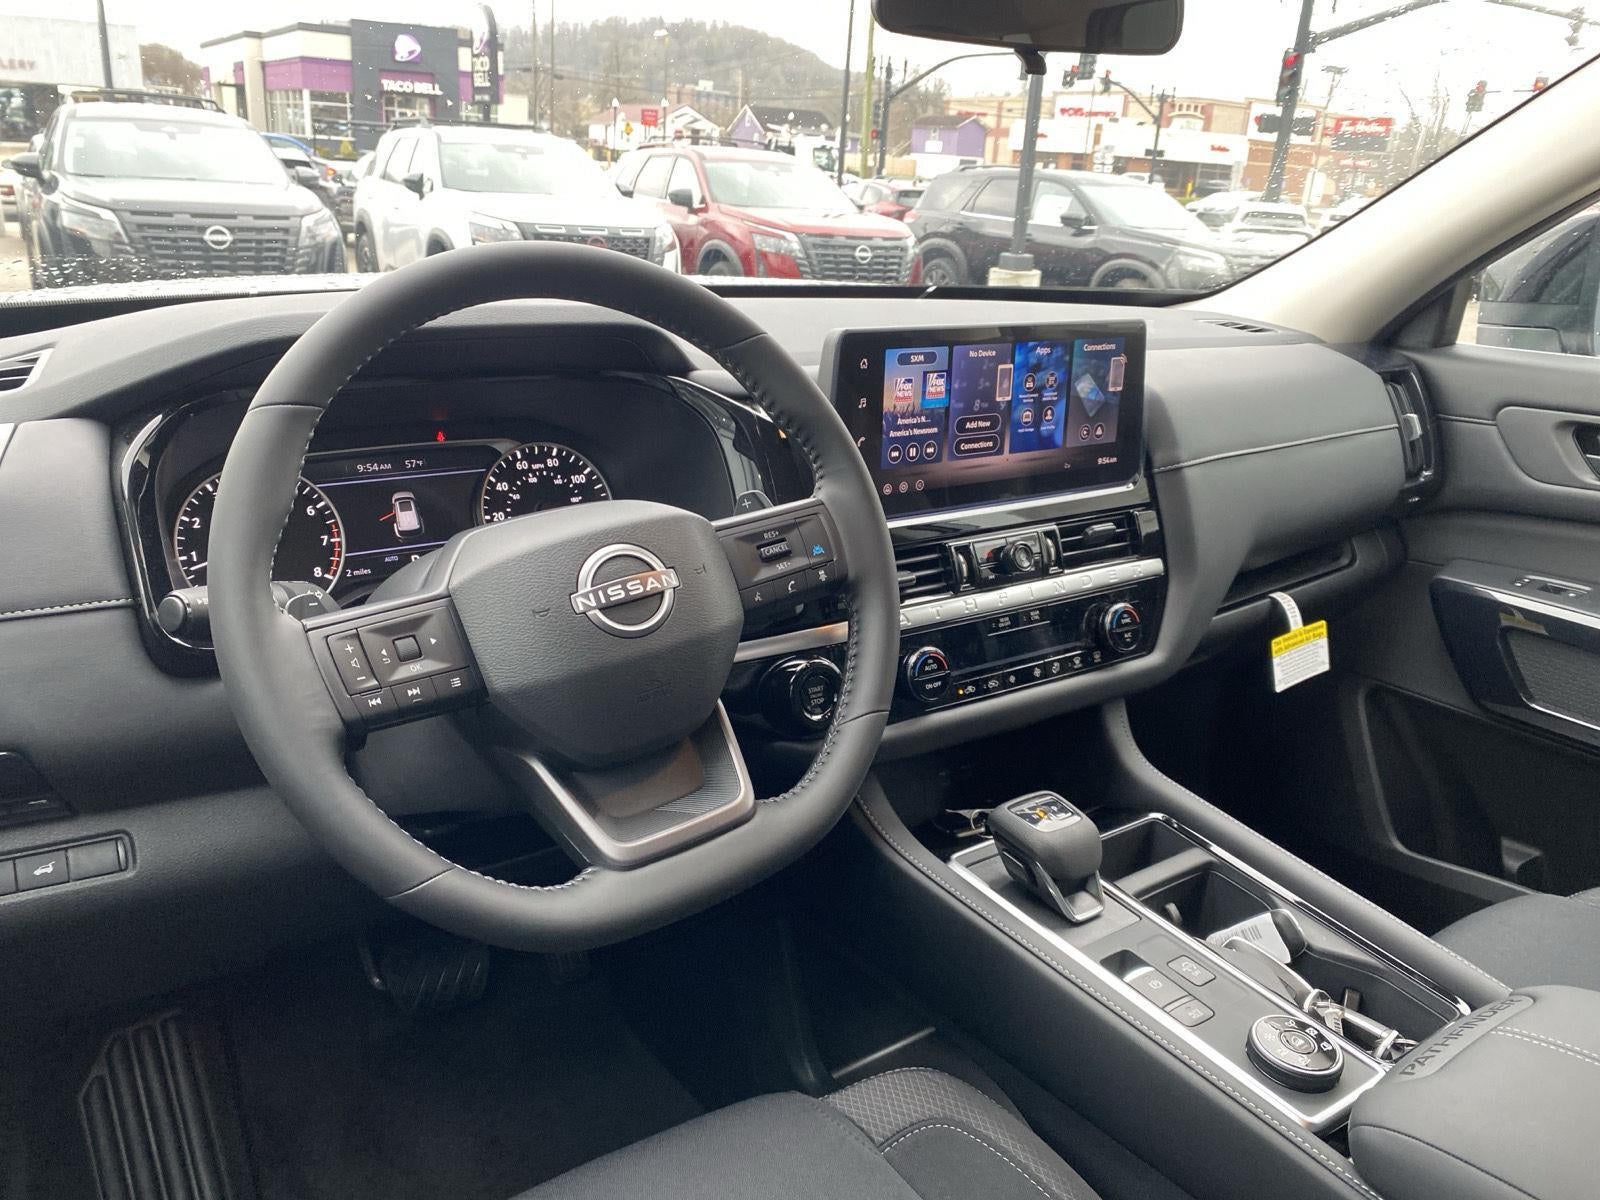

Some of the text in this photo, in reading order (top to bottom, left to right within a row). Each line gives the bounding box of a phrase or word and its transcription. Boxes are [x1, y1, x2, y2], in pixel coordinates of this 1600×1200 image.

[381, 79, 443, 96] TACO BELL
[1036, 347, 1051, 356] Apps
[1084, 343, 1116, 352] Connections
[969, 350, 977, 358] No
[910, 355, 924, 363] SXM
[978, 420, 991, 428] New
[960, 441, 993, 450] Connections
[516, 461, 528, 469] 60
[547, 458, 558, 467] 80
[571, 474, 586, 483] 100
[496, 482, 508, 491] 40
[306, 505, 315, 516] 6
[492, 511, 505, 521] 20
[191, 517, 201, 528] 2
[763, 530, 779, 539] RES+
[320, 535, 328, 545] 7
[764, 544, 789, 556] CANCEL
[190, 551, 198, 561] 1
[313, 566, 322, 577] 8
[346, 568, 372, 577] 2 miles
[575, 572, 677, 611] NISSAN
[899, 563, 1146, 626] ATHFINDER
[410, 663, 423, 672] OK
[925, 663, 938, 671] AUTO
[809, 685, 824, 695] START
[811, 698, 825, 706] STOP
[1399, 998, 1522, 1076] PATHFINDER
